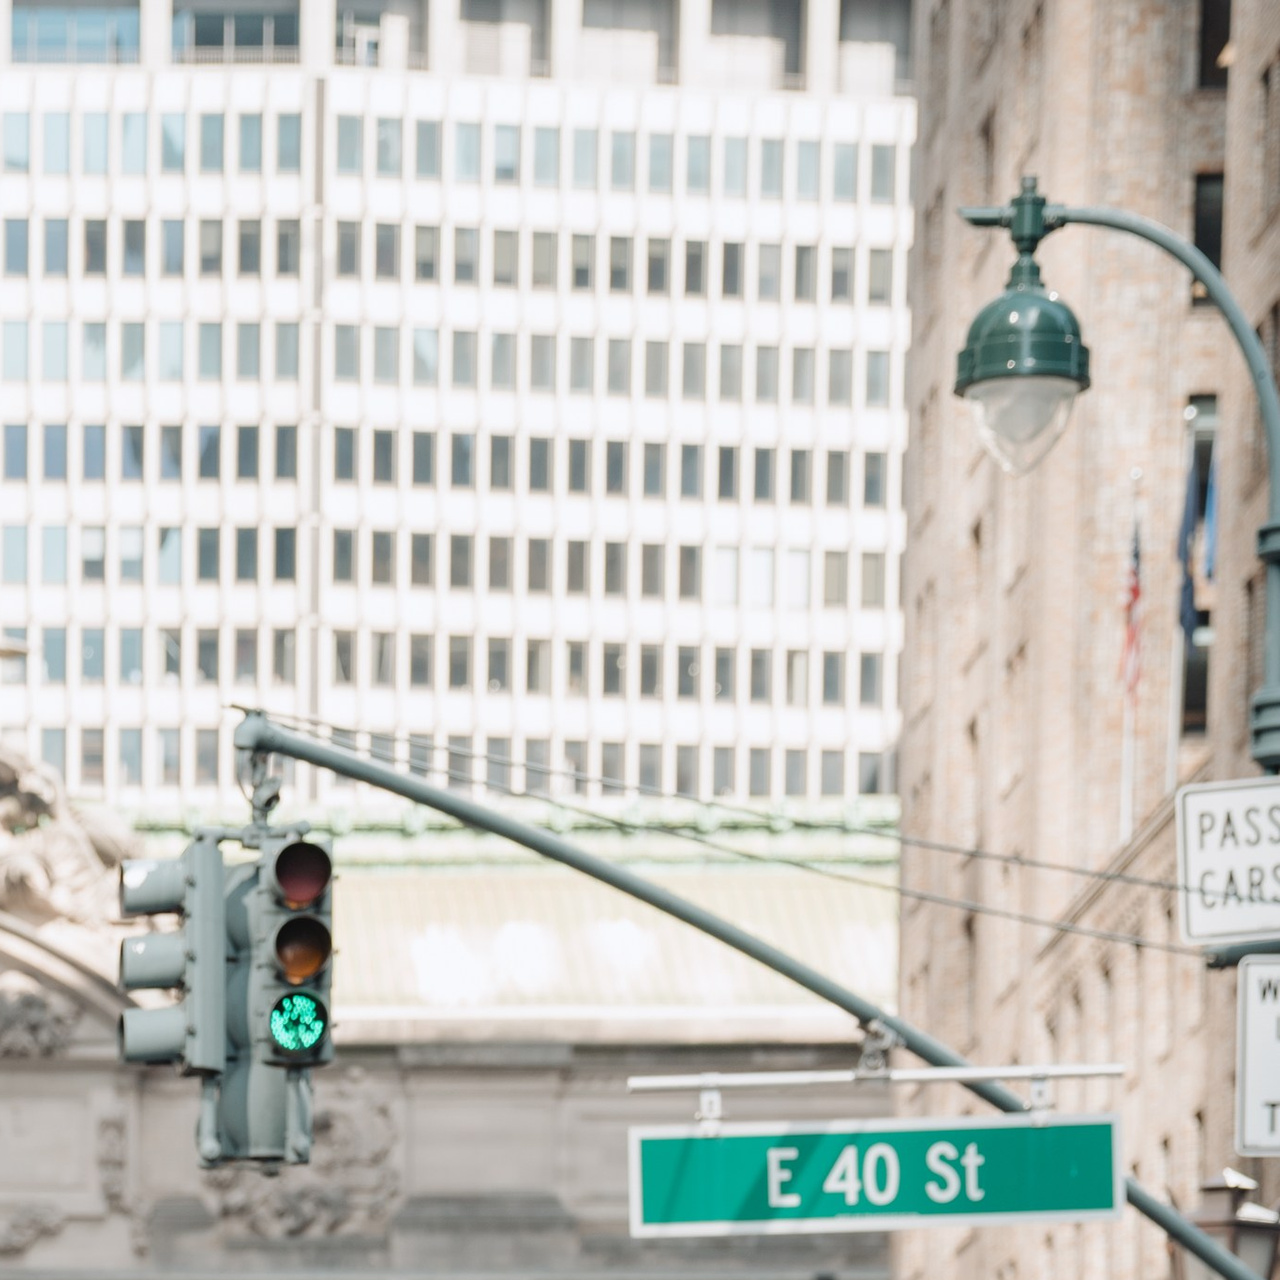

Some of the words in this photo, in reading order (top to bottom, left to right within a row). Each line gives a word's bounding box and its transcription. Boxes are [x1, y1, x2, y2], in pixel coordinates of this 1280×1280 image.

[767, 1147, 802, 1208] E
[823, 1143, 901, 1206] 40
[924, 1141, 986, 1204] St
